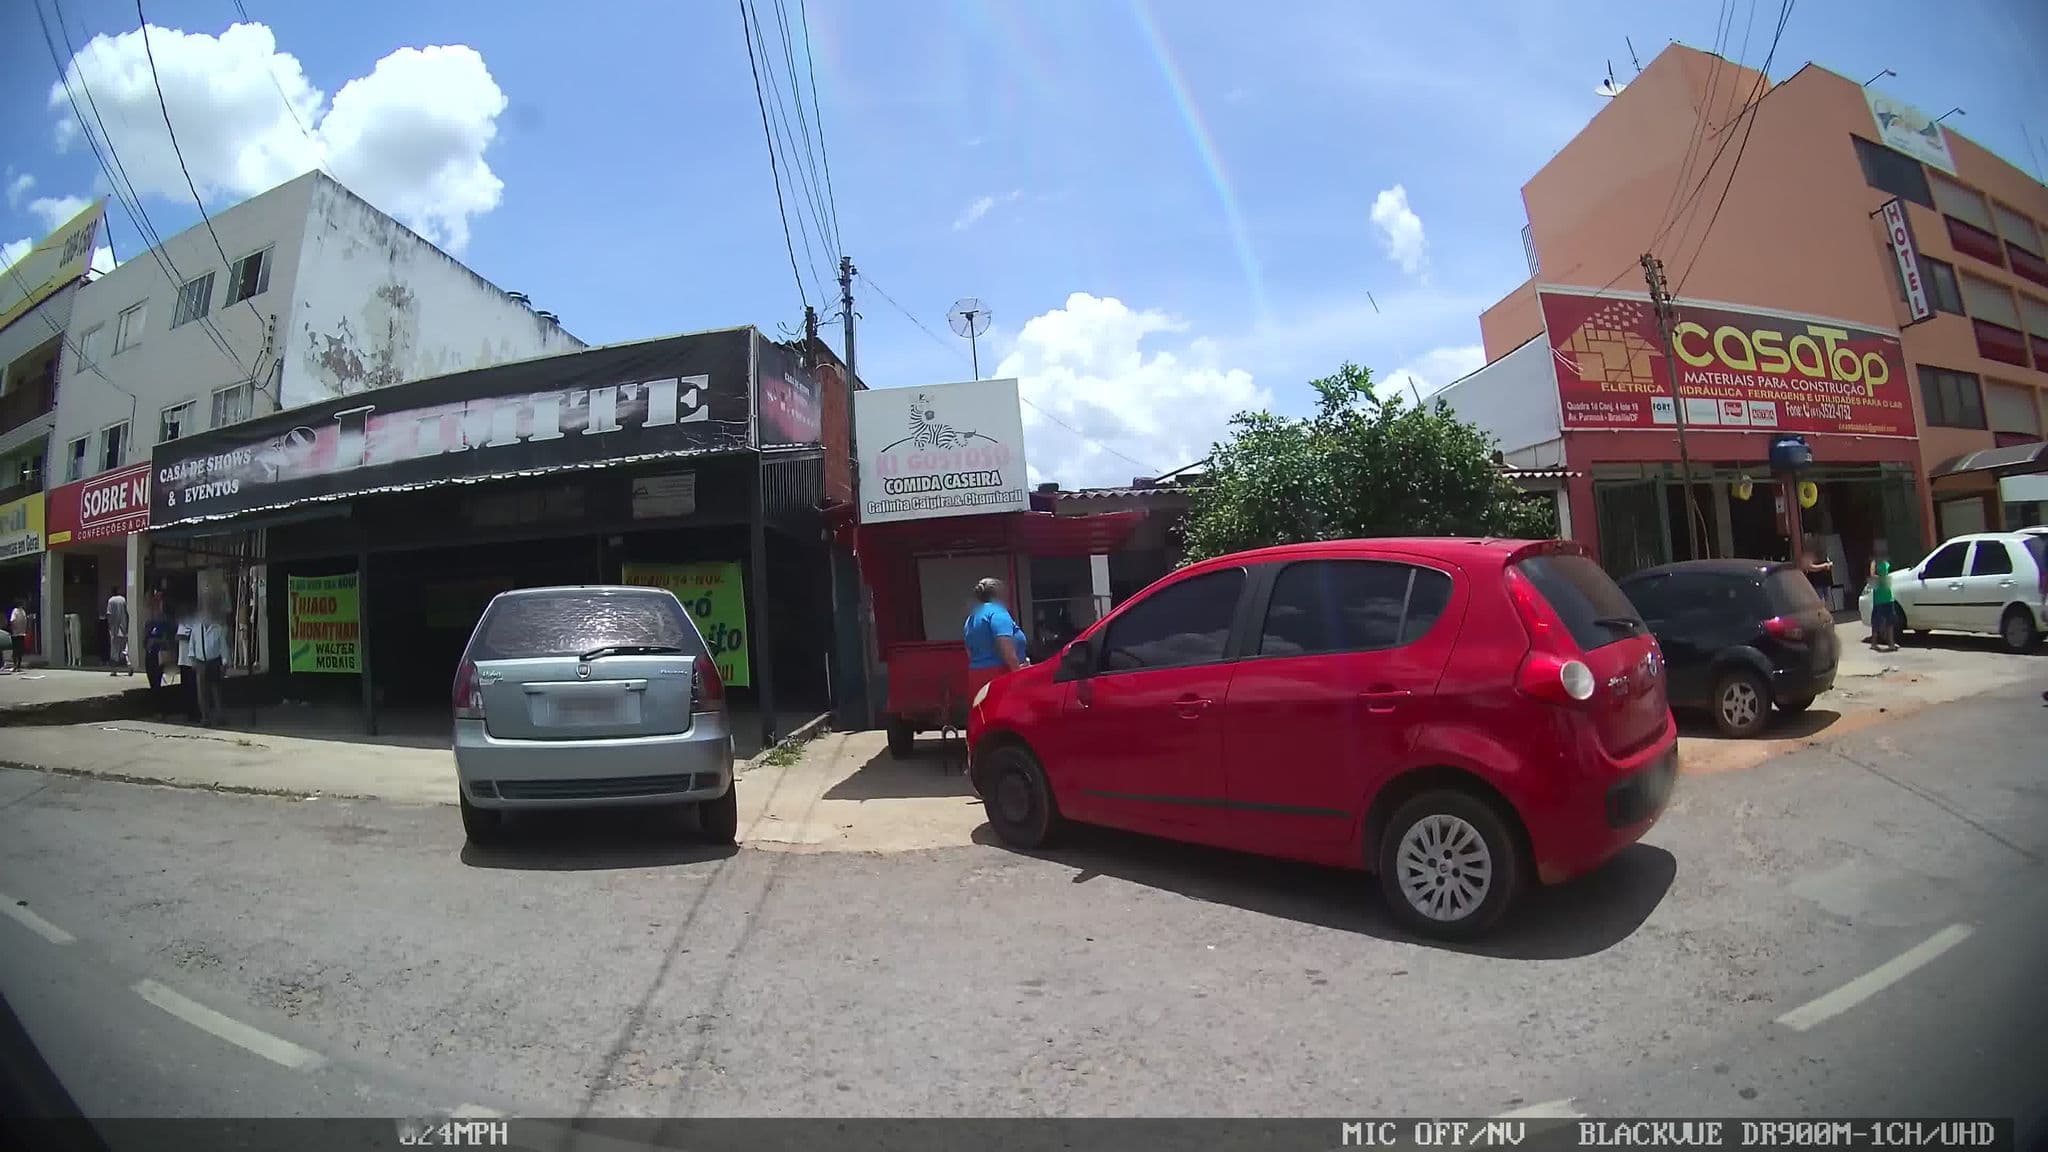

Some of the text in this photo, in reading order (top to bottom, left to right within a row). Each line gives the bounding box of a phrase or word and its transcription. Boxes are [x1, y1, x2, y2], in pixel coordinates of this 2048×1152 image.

[1887, 203, 1925, 315] HOTEL
[1684, 371, 1865, 396] MATERIAIS PARA CONSTRUÇÃO
[160, 448, 252, 483] CASA DE SHOWS
[168, 479, 239, 507] & EVENTOS
[884, 470, 1003, 496] COMIDA CASEIRA
[83, 482, 128, 519] SOBRE
[867, 497, 911, 515] Galinha
[911, 493, 952, 511] Caipira
[954, 494, 964, 504] &
[316, 642, 355, 656] WALTER
[316, 656, 355, 670] MORAIS
